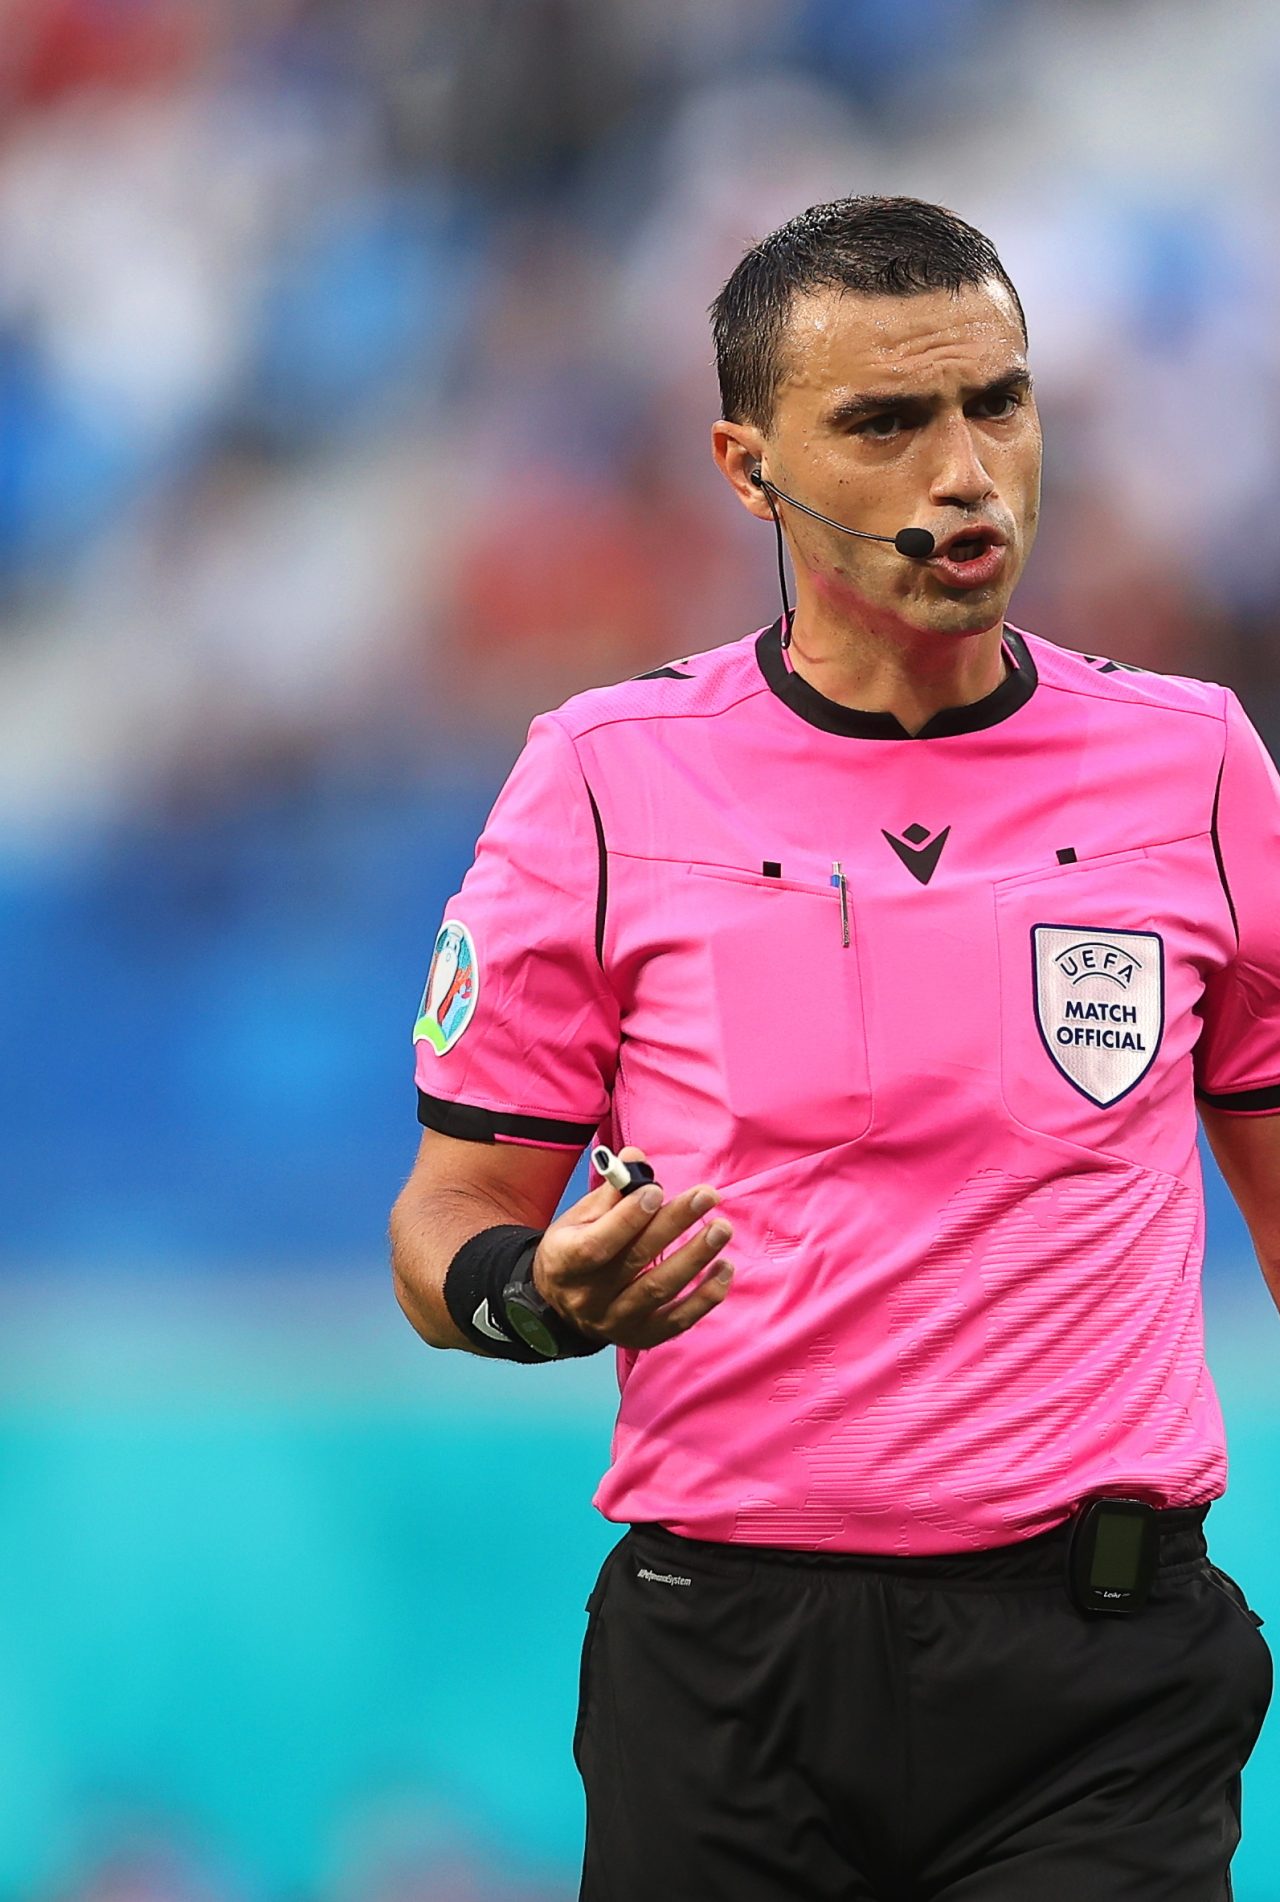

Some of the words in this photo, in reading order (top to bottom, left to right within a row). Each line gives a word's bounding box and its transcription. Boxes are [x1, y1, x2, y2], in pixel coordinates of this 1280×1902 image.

[1060, 949, 1133, 983] UEFA
[1065, 1001, 1137, 1024] MATCH
[1057, 1026, 1146, 1051] OFFICIAL
